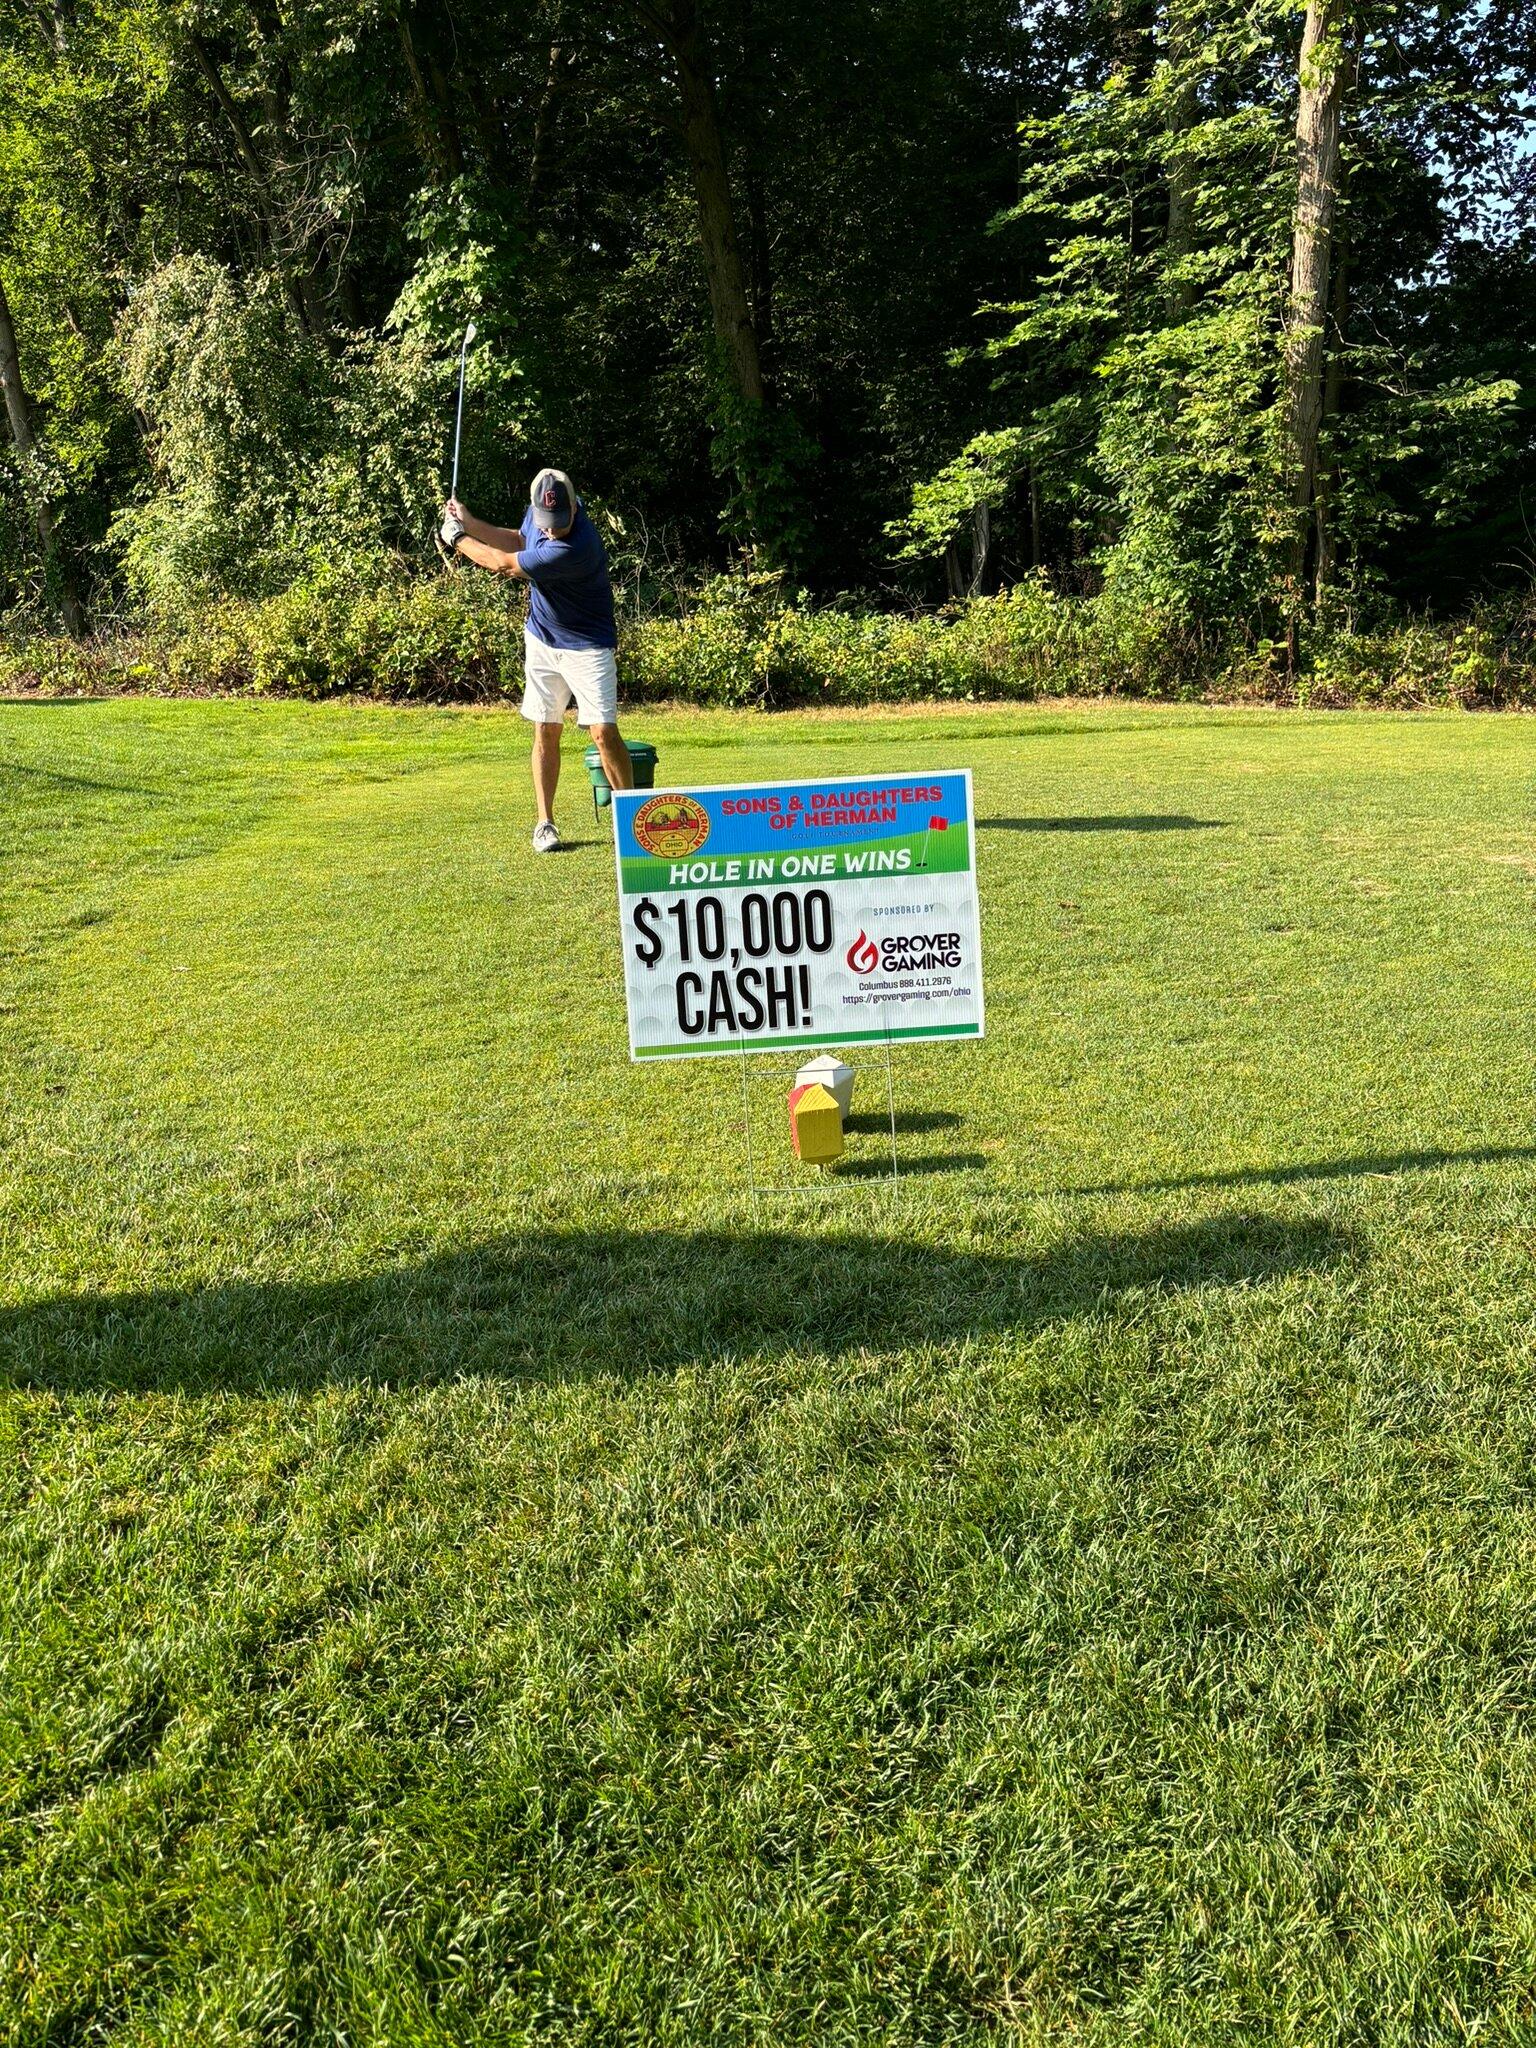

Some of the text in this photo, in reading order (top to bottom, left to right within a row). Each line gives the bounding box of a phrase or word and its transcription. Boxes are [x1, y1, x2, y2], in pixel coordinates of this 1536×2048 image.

[544, 490, 557, 507] C
[637, 796, 688, 821] DAUGHTERS
[721, 786, 942, 816] SONS & DAUGHTERS
[693, 808, 708, 847] HERMAN
[769, 806, 897, 831] OF HERMAN
[637, 830, 656, 851] SONS
[665, 841, 684, 849] OHIO
[669, 848, 912, 885] HOLE IN ONE WINS
[873, 904, 935, 916] SPONSORED BY
[633, 889, 834, 970] $10,000
[881, 933, 960, 954] GROVER
[882, 951, 961, 972] GAMING
[842, 987, 971, 1004] https://grovergaming.com/ohio
[859, 980, 899, 991] Columbus
[675, 963, 813, 1036] CASH!
